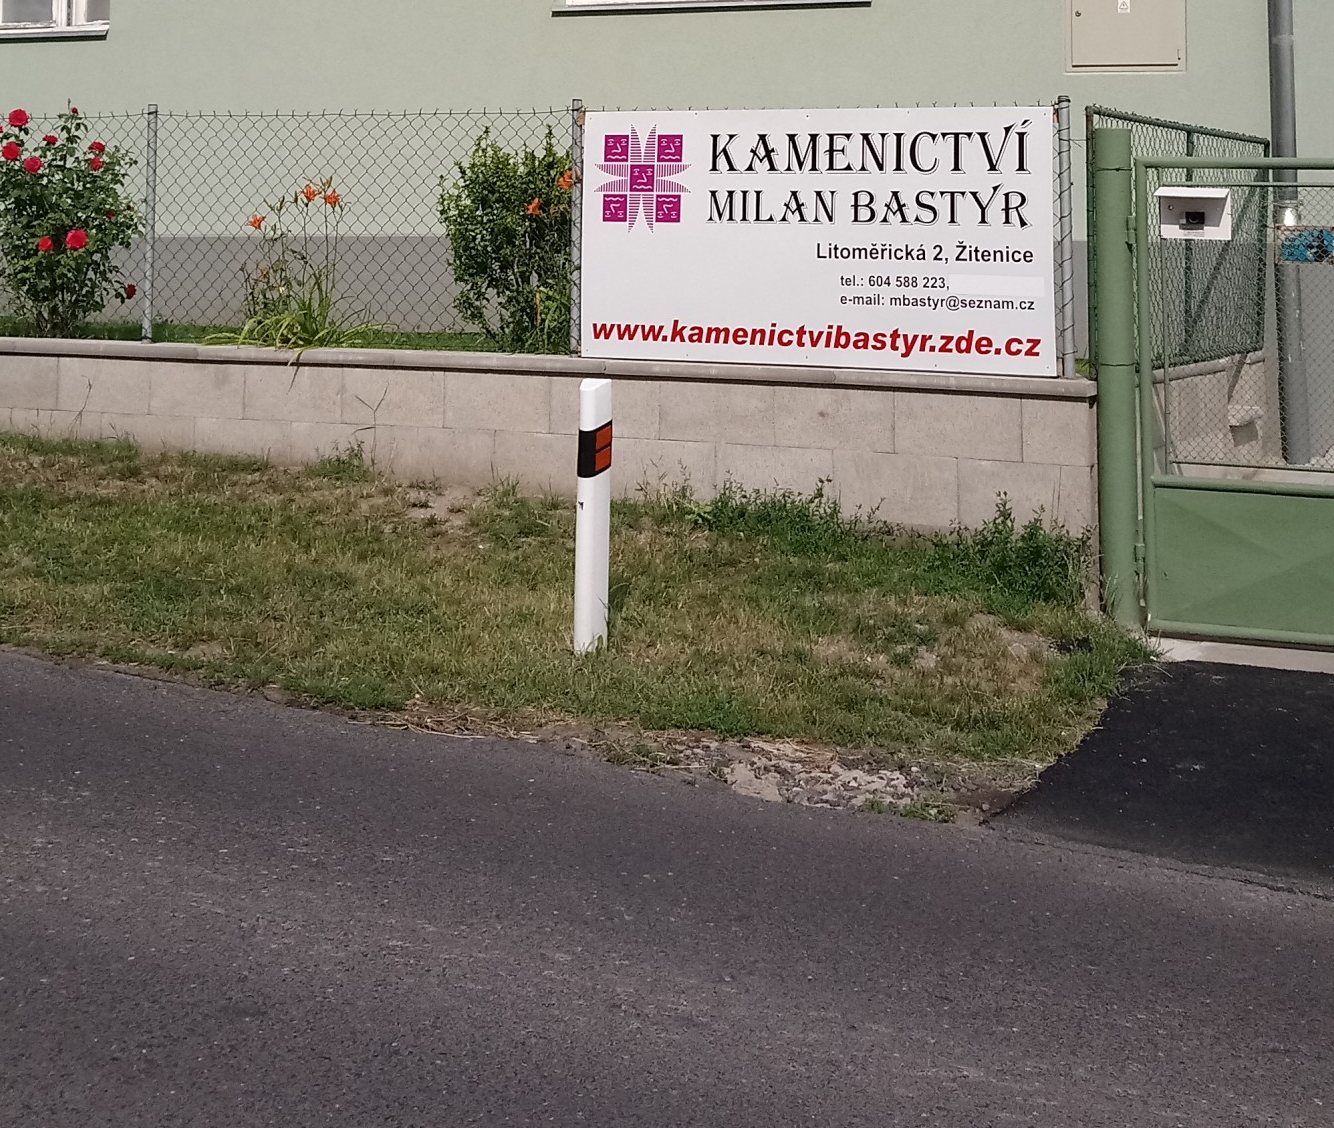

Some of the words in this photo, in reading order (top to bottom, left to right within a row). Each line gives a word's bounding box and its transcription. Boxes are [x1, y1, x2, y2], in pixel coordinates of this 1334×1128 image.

[708, 119, 1033, 175] KAMENICTVÍ
[707, 189, 837, 224] MILAN
[816, 242, 927, 261] Litoměřická
[932, 245, 949, 264] 2,
[955, 240, 1035, 263] Žitenice
[840, 274, 864, 287] tel.:
[868, 276, 891, 288] 604
[895, 277, 918, 289] 588
[922, 277, 950, 291] 223,
[840, 293, 885, 306] e-mail:
[889, 295, 1036, 311] mbastyr@seznam.cz
[592, 319, 1043, 358] www.kamenictvibastyr.zde.cz
